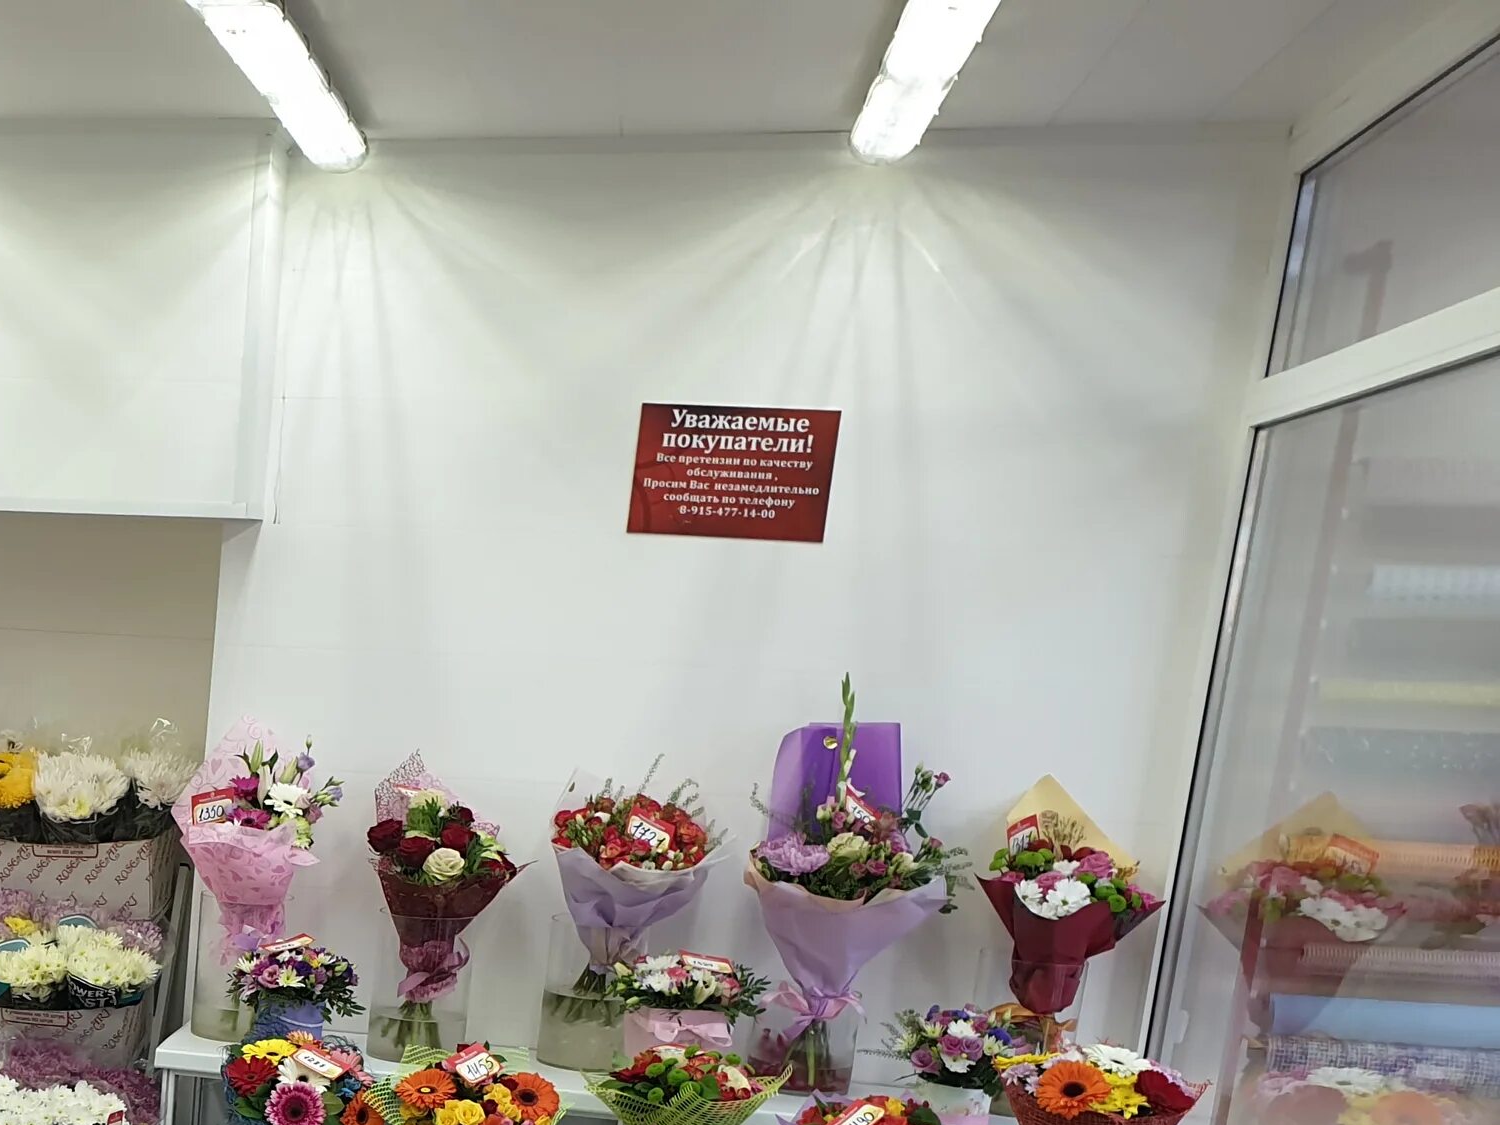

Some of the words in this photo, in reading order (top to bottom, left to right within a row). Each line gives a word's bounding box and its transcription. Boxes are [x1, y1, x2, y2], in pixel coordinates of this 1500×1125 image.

[671, 409, 810, 432] Уважаемые
[662, 433, 814, 454] покупатели!
[656, 452, 676, 463] Все
[679, 454, 740, 466] претензии
[743, 458, 757, 467] по
[760, 458, 813, 470] качеству
[643, 478, 687, 490] Просим
[689, 481, 709, 490] Вас
[714, 483, 819, 496] незамедлительно
[663, 493, 719, 504] сообщать
[722, 496, 735, 505] по
[738, 496, 795, 509] телефону
[679, 505, 776, 519] 8-915-477-14-00
[199, 805, 224, 821] 1350
